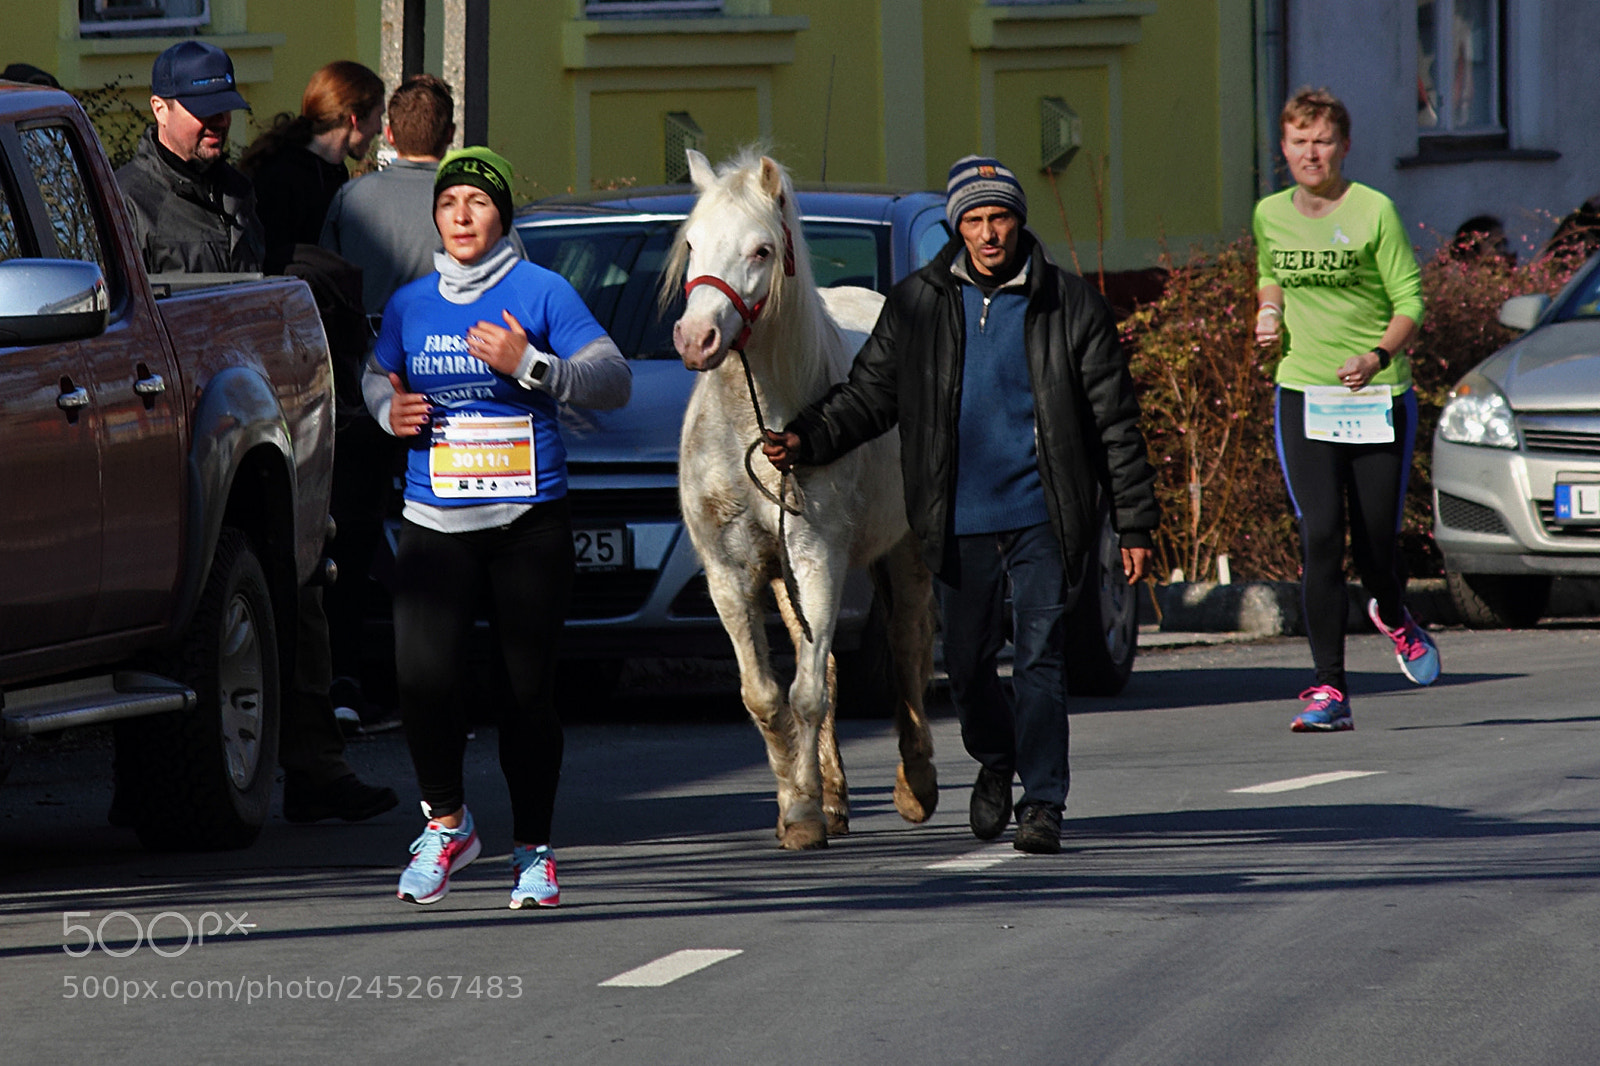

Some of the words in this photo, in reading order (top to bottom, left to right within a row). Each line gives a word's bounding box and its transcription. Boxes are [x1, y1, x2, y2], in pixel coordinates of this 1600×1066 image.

[452, 452, 509, 468] 3011/1
[1578, 489, 1600, 515] L
[575, 532, 614, 563] 25
